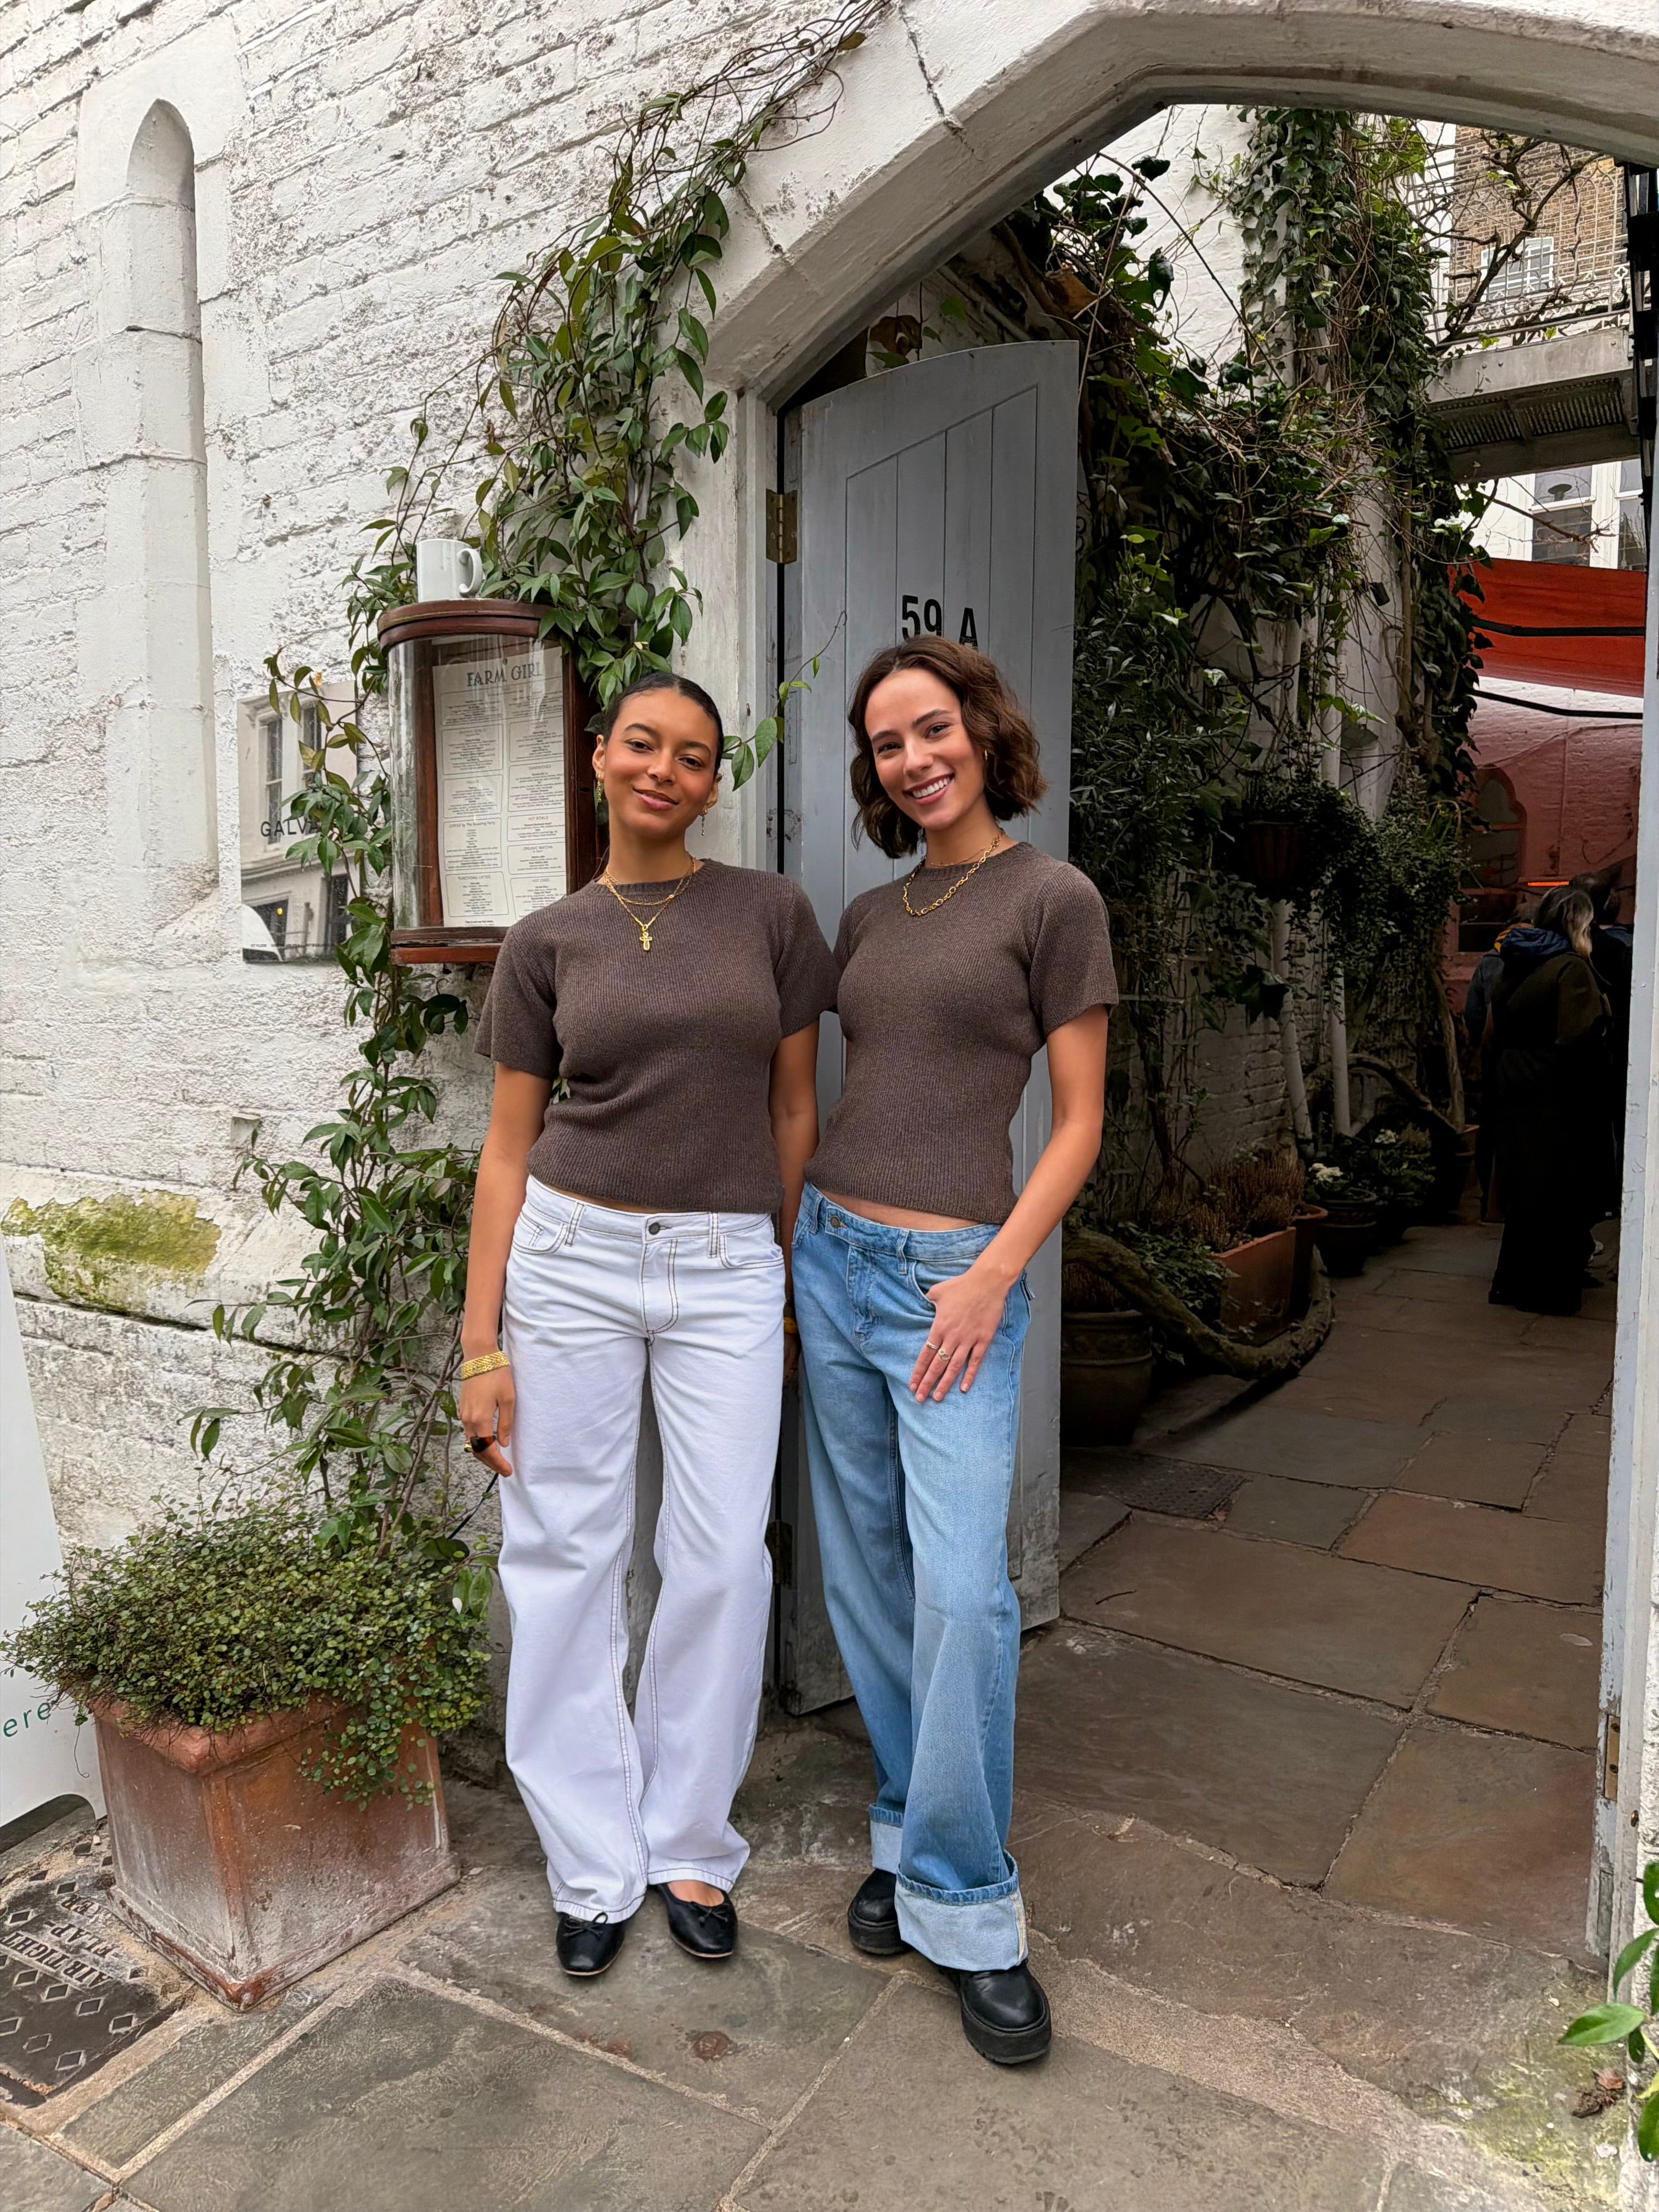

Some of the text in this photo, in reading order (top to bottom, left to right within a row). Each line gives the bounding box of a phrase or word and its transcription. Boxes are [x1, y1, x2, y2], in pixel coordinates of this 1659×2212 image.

[902, 595, 979, 648] 59 A
[466, 662, 543, 686] FARM GIRL
[260, 819, 318, 837] GALVA
